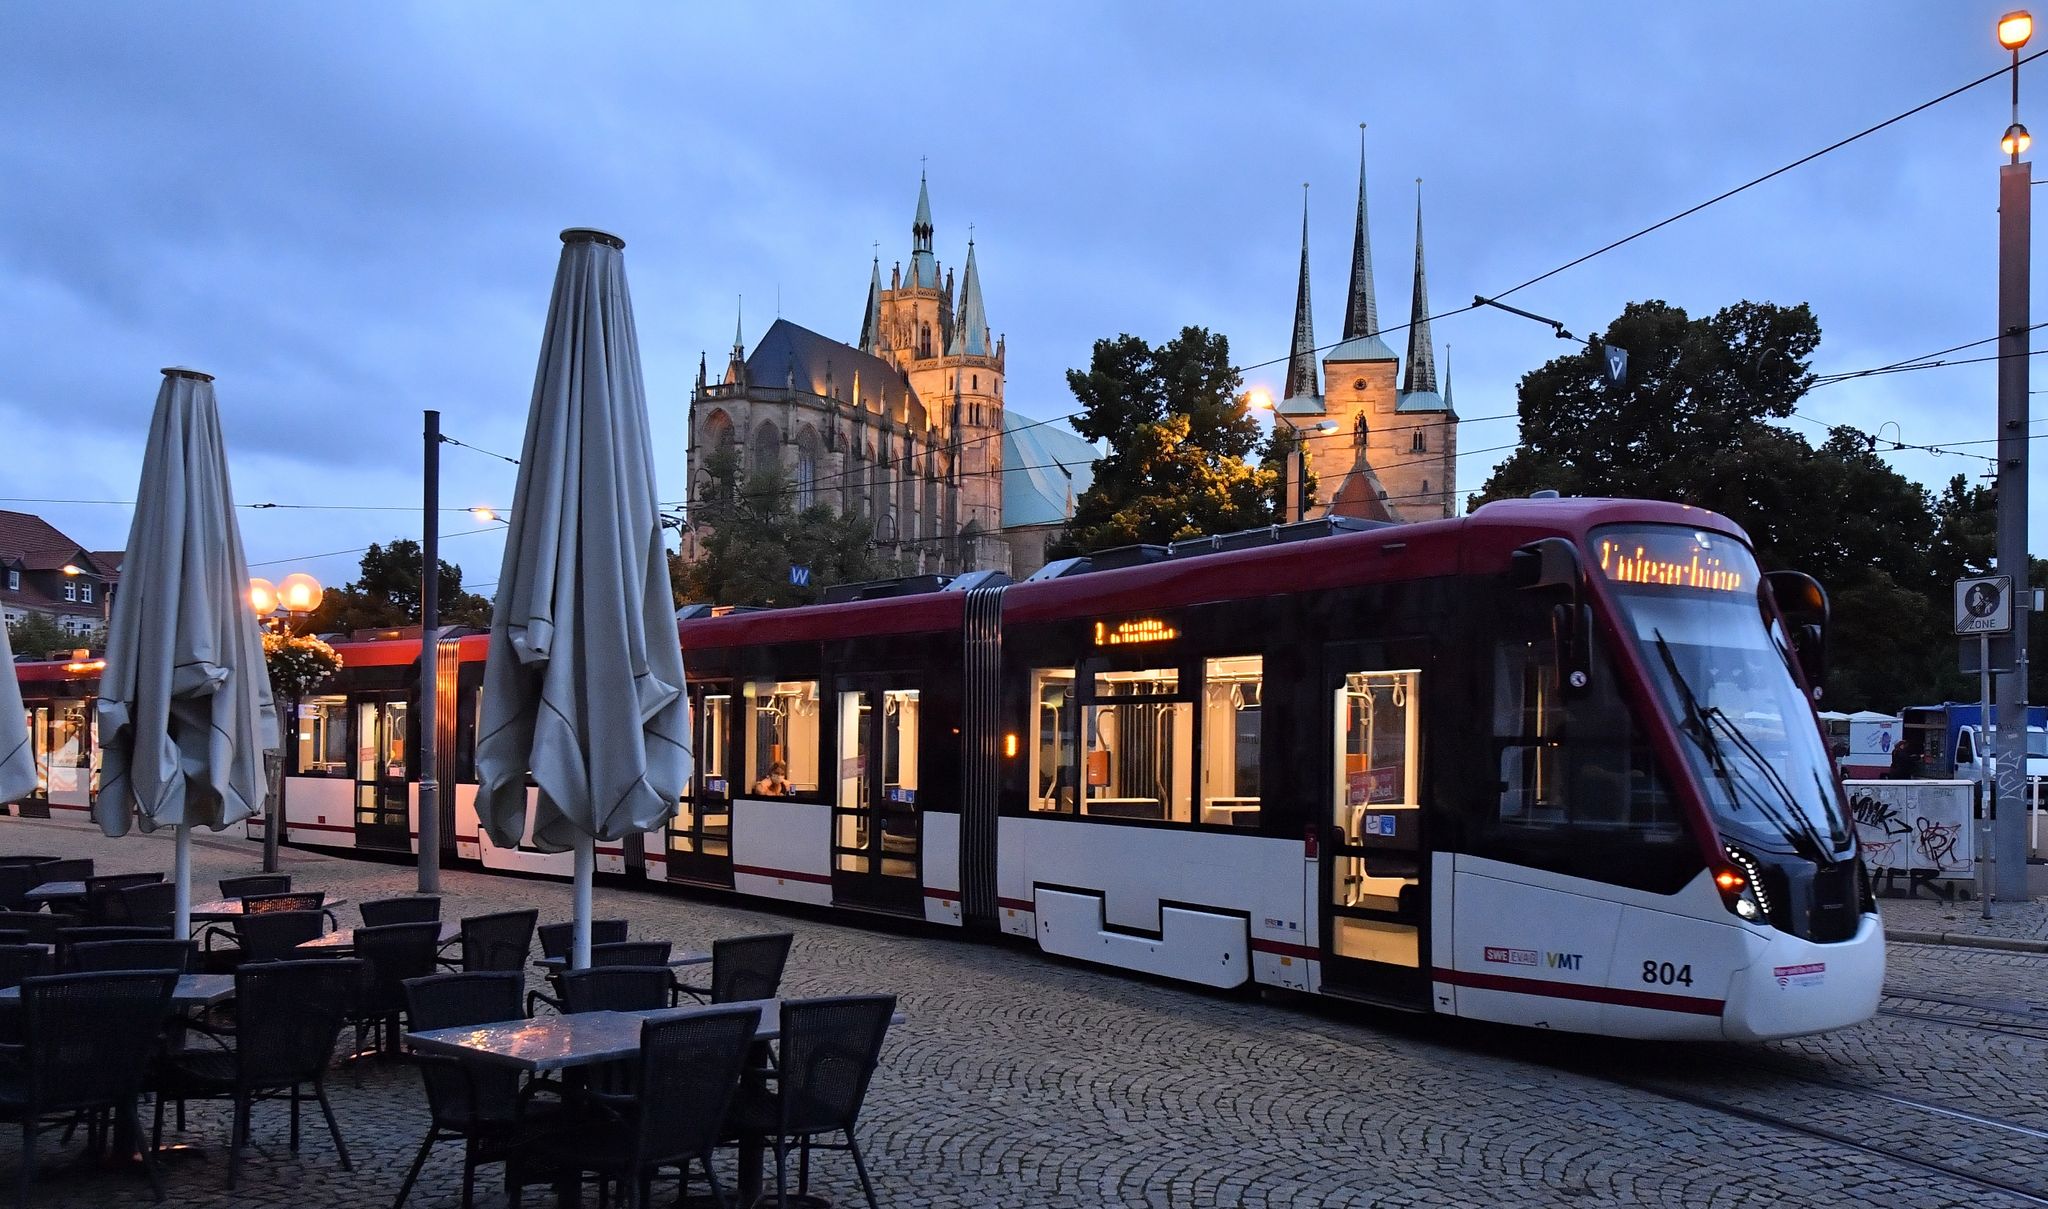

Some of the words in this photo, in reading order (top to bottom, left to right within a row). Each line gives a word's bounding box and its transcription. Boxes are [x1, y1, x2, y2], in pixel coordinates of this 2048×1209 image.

[792, 567, 809, 585] W
[1969, 618, 1996, 630] ZONE
[1486, 948, 1508, 962] SWE
[1546, 951, 1583, 971] VMT
[1642, 960, 1694, 987] 804
